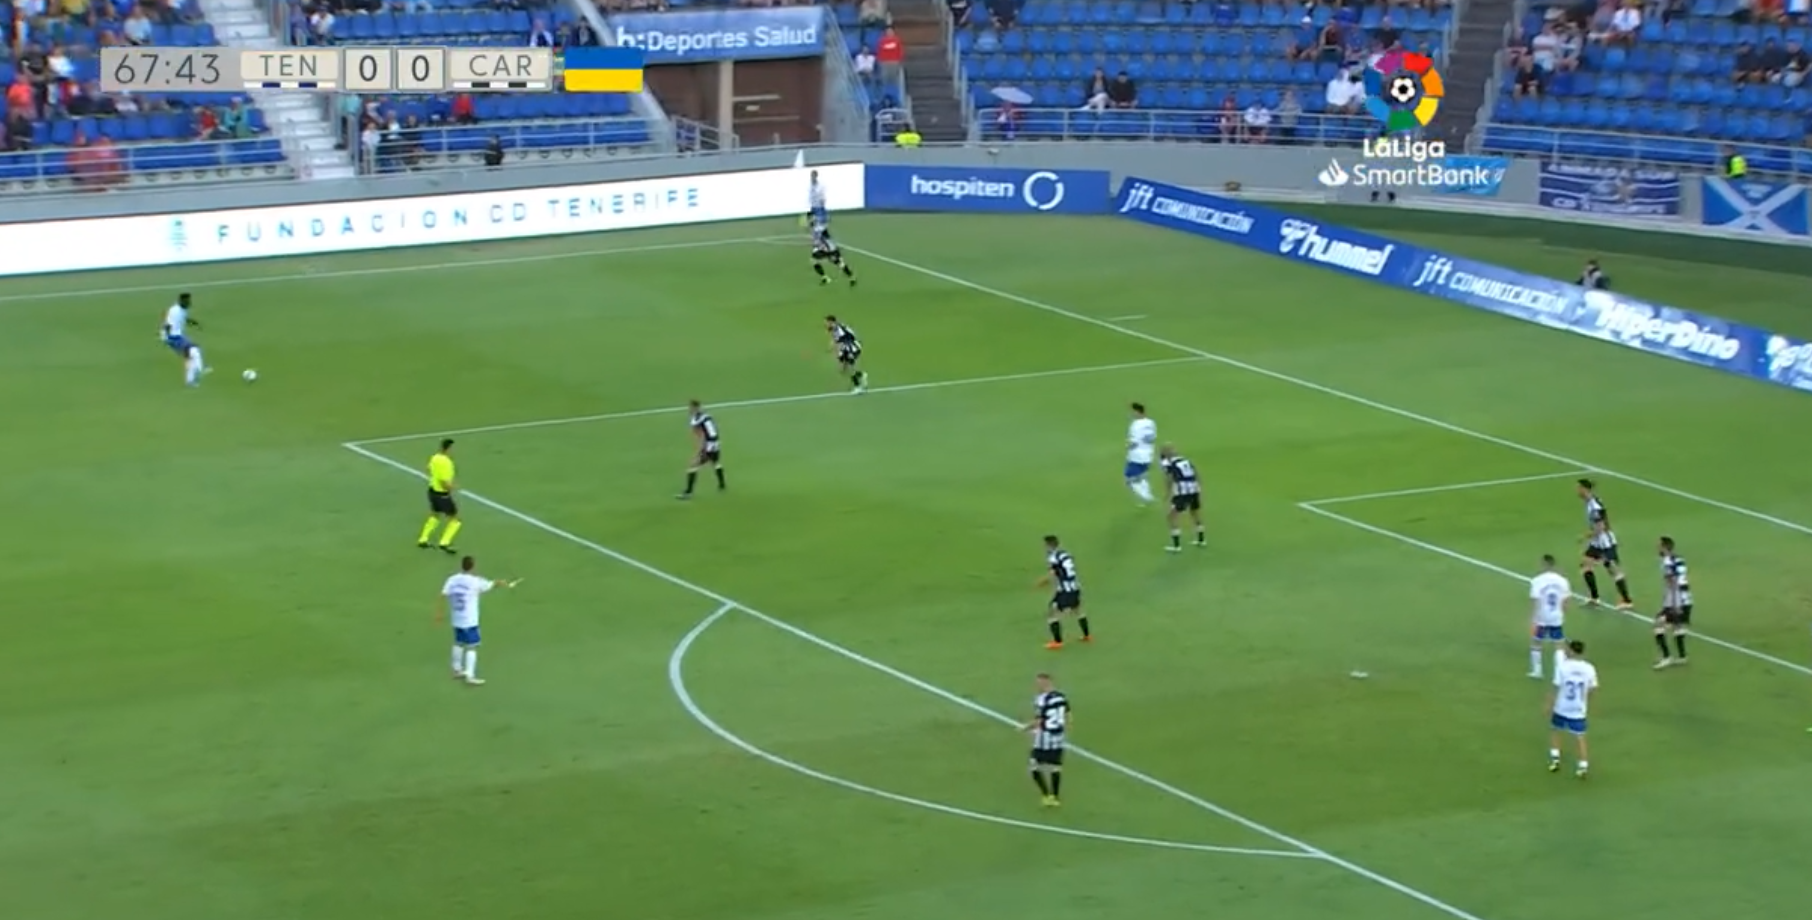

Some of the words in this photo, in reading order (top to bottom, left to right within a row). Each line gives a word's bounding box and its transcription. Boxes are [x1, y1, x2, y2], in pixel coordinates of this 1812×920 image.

[754, 25, 816, 47] Salud
[910, 174, 1015, 200] hospiten
[1119, 182, 1155, 213] jft
[490, 202, 526, 223] CD
[547, 188, 699, 218] TENERIFE
[1297, 225, 1395, 276] hummel
[1412, 254, 1454, 287] jft
[1589, 292, 1740, 360] HiperDino
[1565, 680, 1585, 701] 31
